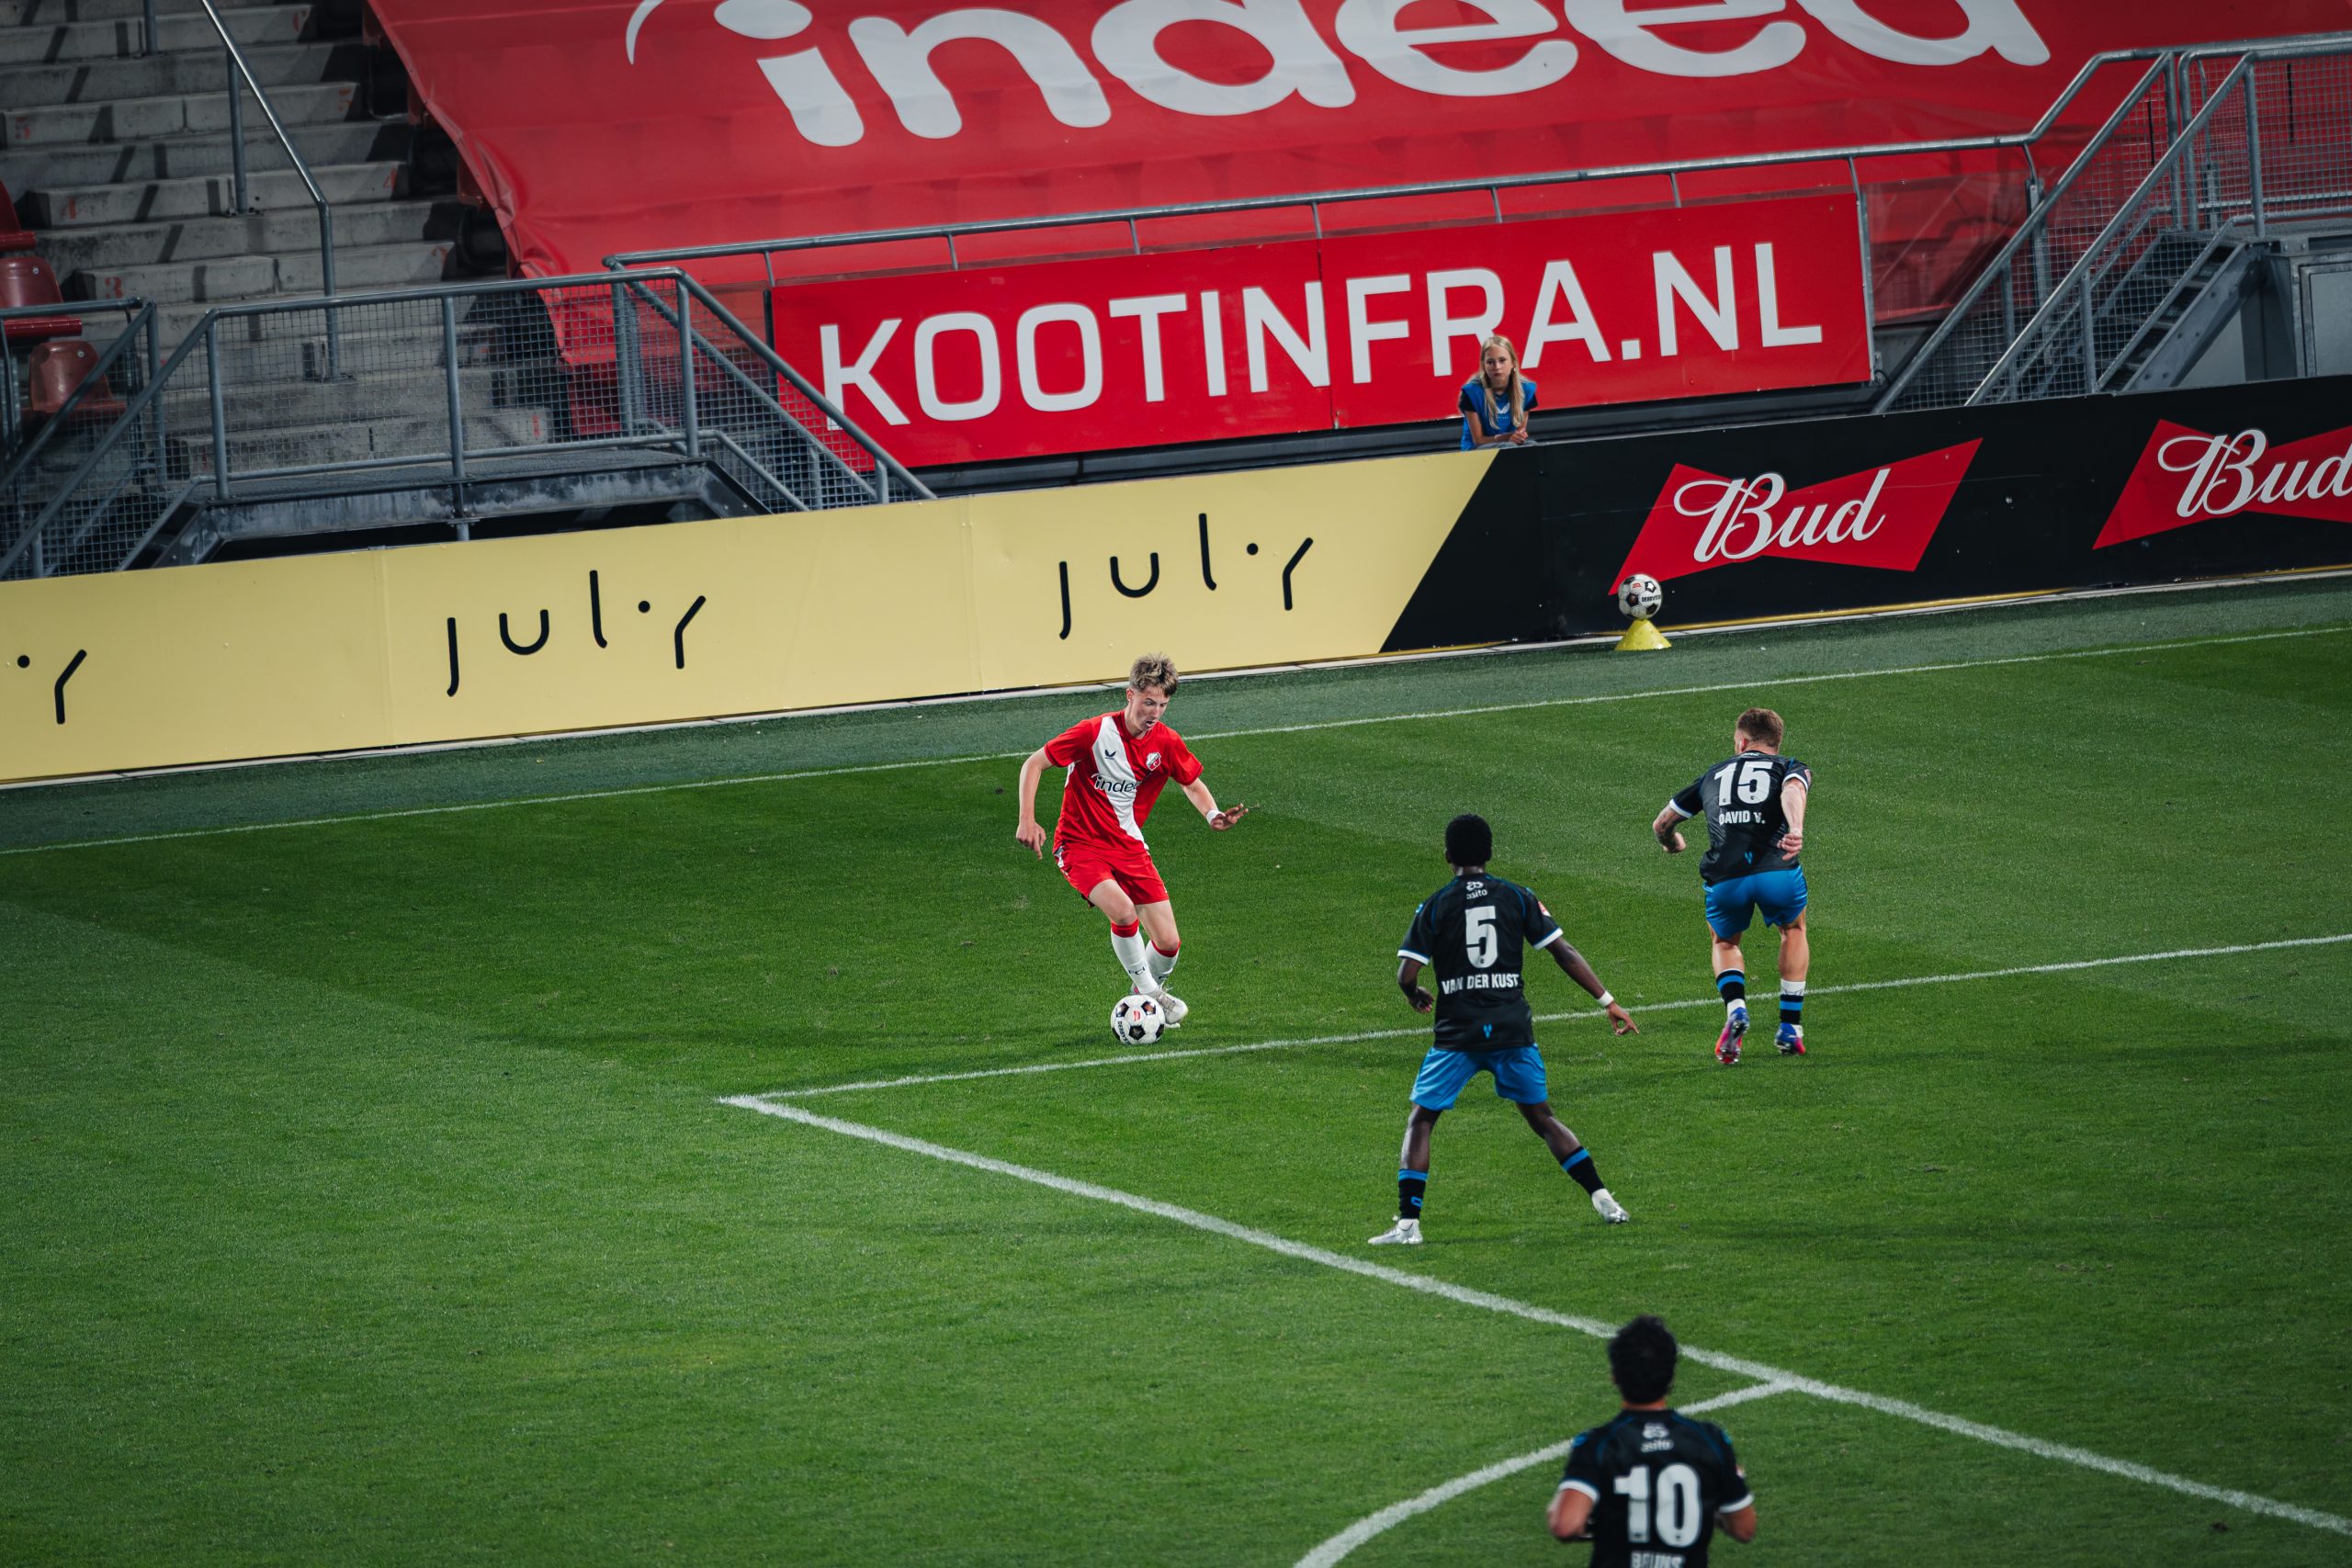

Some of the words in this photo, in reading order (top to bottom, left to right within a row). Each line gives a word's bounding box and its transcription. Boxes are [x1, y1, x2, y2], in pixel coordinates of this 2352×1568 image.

[820, 243, 1824, 432] KOOTINFRA.NL
[2157, 429, 2352, 518] Bud
[1673, 468, 1891, 563] Bud
[1713, 761, 1774, 807] 15
[1718, 810, 1751, 826] DAVID
[1464, 905, 1498, 969] 5
[1442, 976, 1464, 995] VAN
[1466, 974, 1489, 990] DER
[1491, 974, 1520, 988] KUST
[1613, 1462, 1701, 1549] 10
